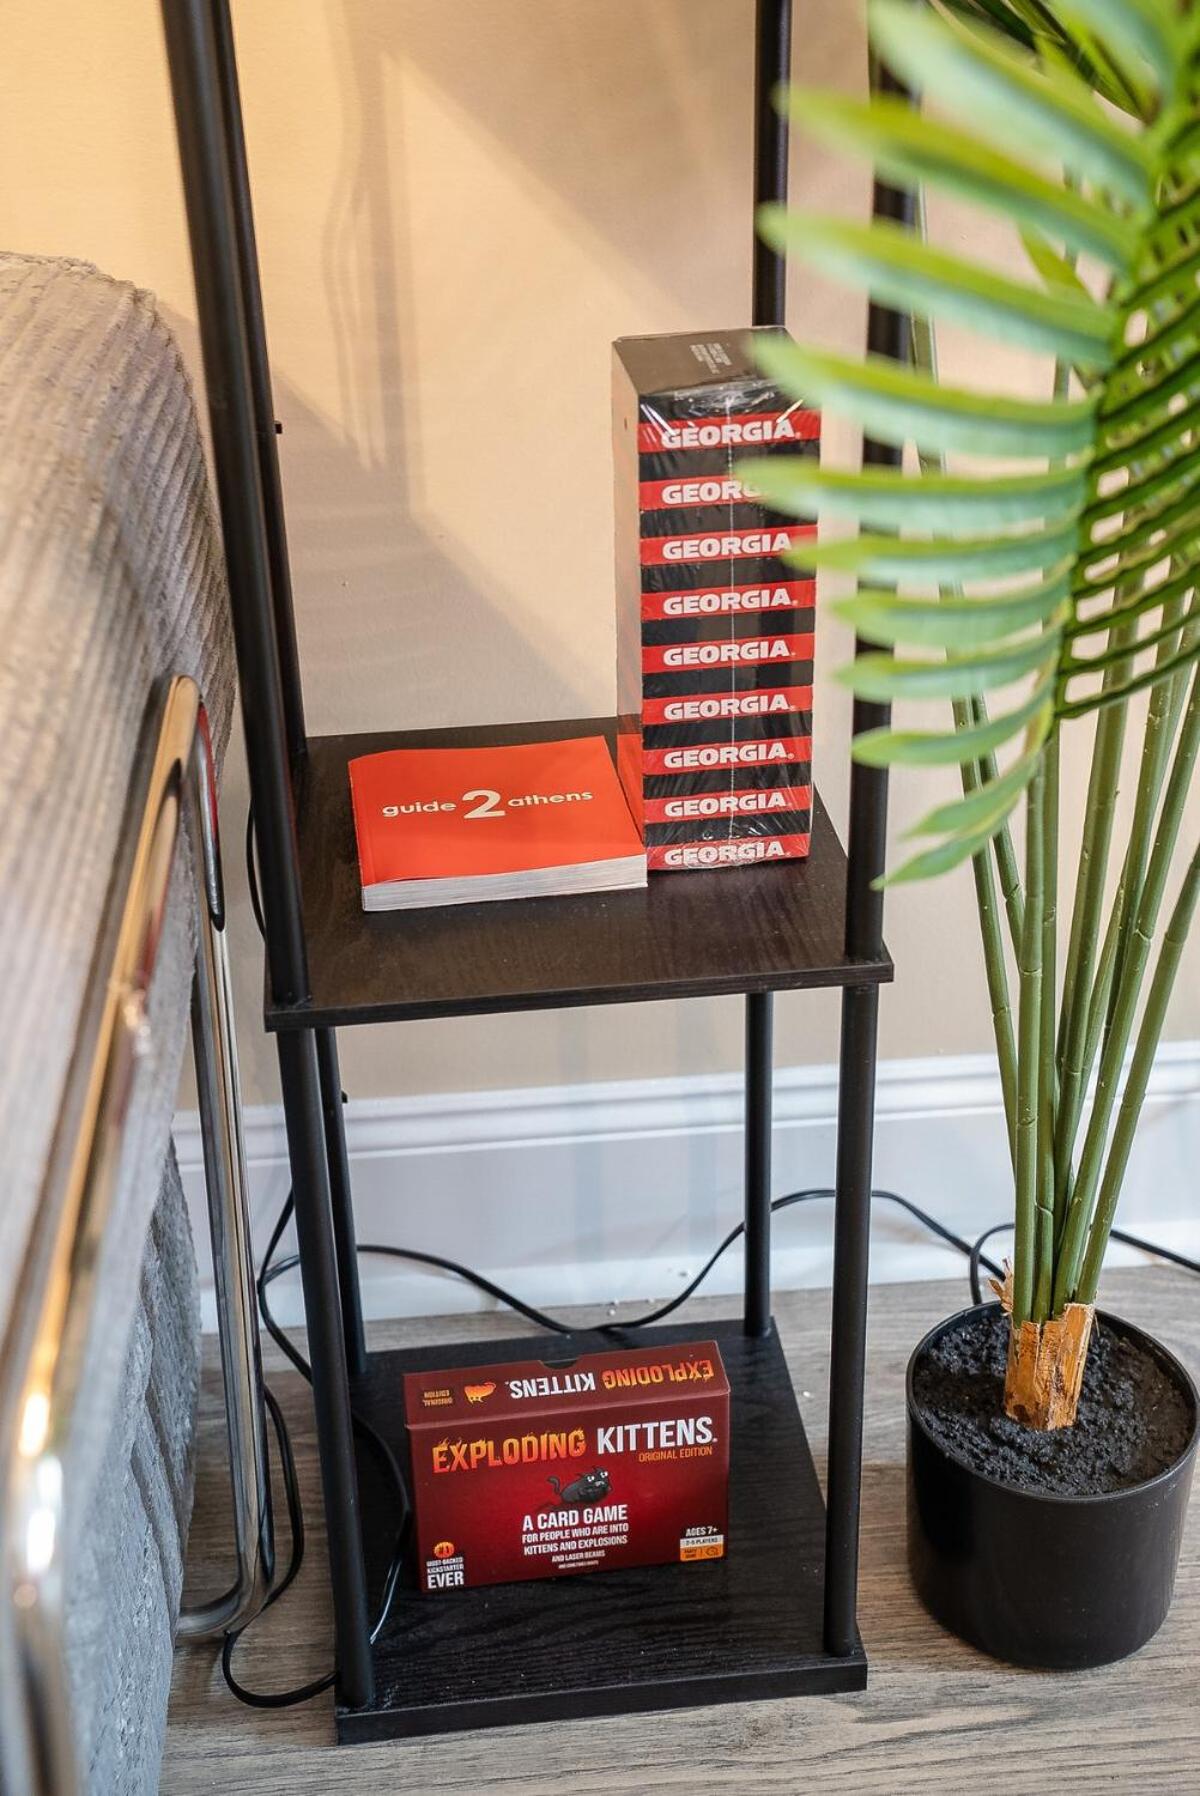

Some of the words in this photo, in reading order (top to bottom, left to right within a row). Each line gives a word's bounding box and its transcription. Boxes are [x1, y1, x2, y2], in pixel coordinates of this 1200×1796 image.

[661, 420, 796, 449] GEORGIA
[661, 480, 766, 505] GEORG
[662, 532, 793, 560] GEORGIA
[662, 588, 791, 615] GEORGIA
[663, 639, 790, 666] GEORGIA
[663, 694, 790, 721] GEORGIA
[663, 742, 788, 768] GEORGIA
[382, 800, 457, 817] guide
[462, 789, 506, 819] 2
[508, 790, 594, 808] athens
[664, 792, 787, 818] GEORGIA
[664, 840, 785, 866] GEORGIA
[510, 1372, 596, 1399] KITTENS
[602, 1360, 715, 1390] EXPLODING
[432, 1426, 587, 1474] EXPLODING
[597, 1416, 714, 1455] KITTENS
[638, 1450, 678, 1463] ORIGINAL
[679, 1446, 713, 1459] EDITION
[522, 1515, 534, 1532] A
[537, 1510, 579, 1530] CARD
[583, 1504, 628, 1524] GAME
[685, 1527, 707, 1537] AGES
[707, 1525, 719, 1535] 7+
[522, 1533, 539, 1544] FOR
[540, 1529, 571, 1542] PEOPLE
[571, 1527, 591, 1538] WHO
[592, 1525, 608, 1535] ARE
[609, 1523, 629, 1533] INTO
[524, 1543, 559, 1556] KITTENS
[559, 1541, 577, 1551] AND
[578, 1535, 628, 1549] EXPLOSIONS
[552, 1555, 565, 1563] AND
[565, 1552, 584, 1561] LASER
[427, 1571, 465, 1589] EVER
